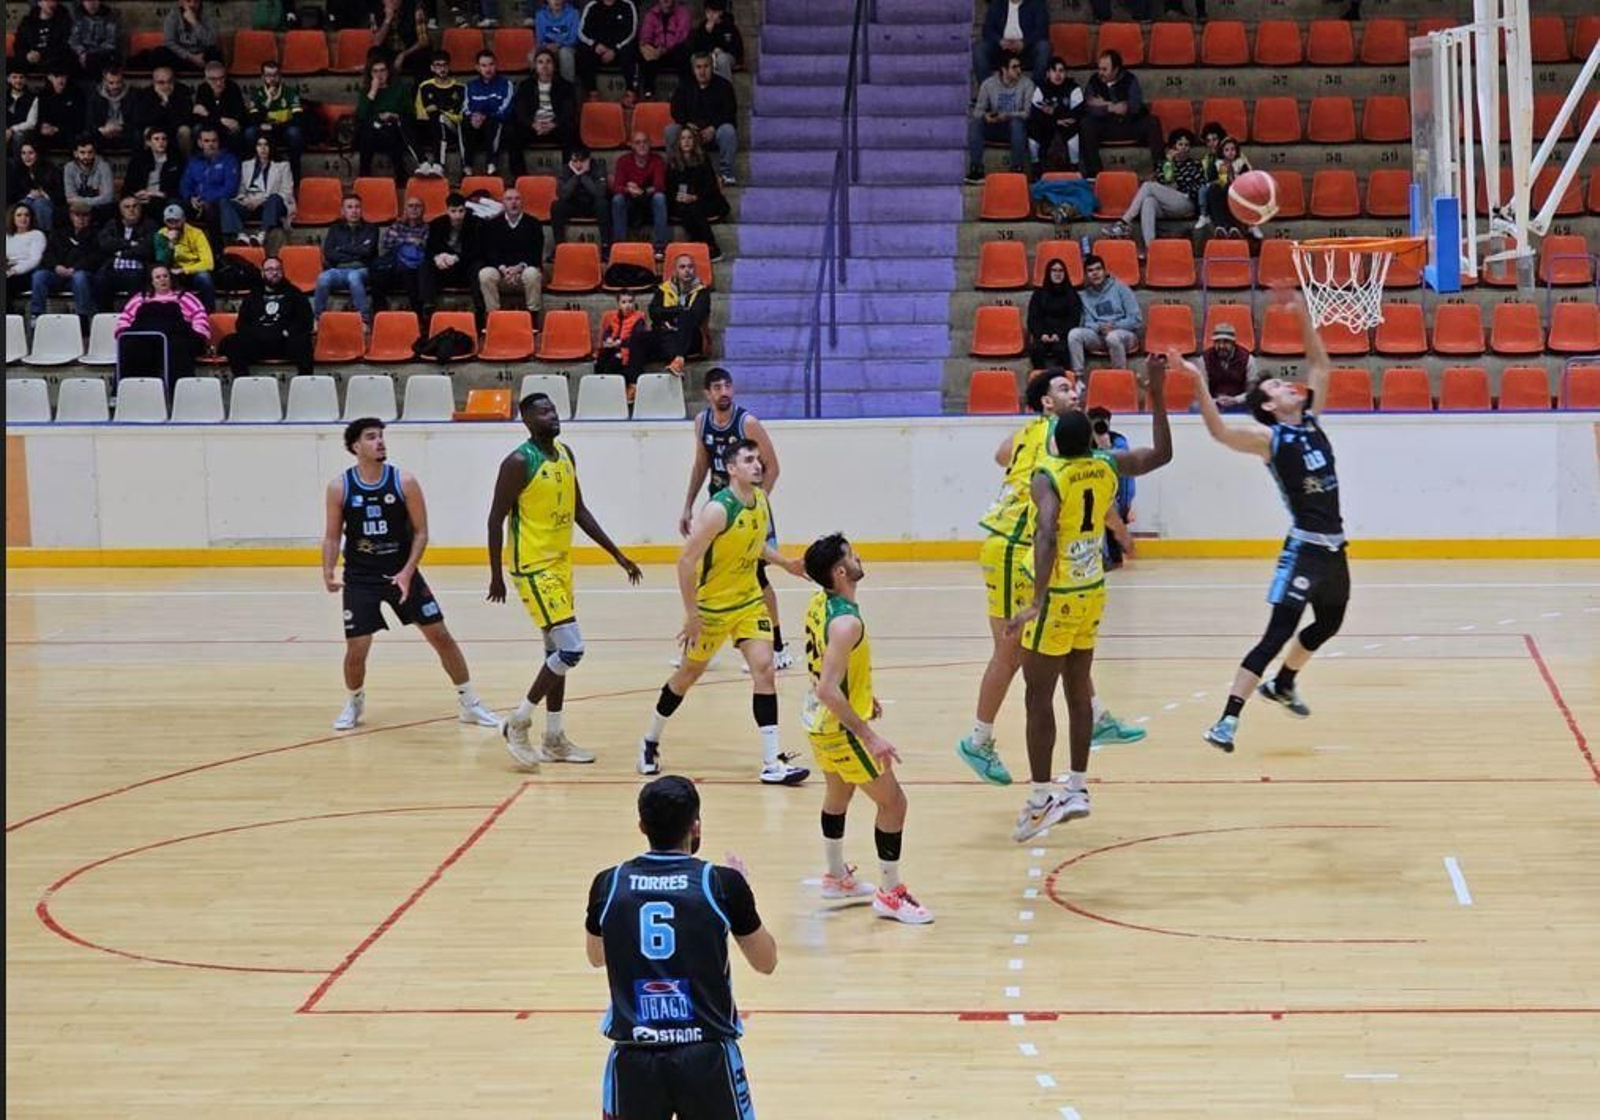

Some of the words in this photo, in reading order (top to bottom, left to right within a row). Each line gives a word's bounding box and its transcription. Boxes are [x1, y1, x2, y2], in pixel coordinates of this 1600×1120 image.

[1080, 488, 1095, 533] 1
[363, 521, 388, 535] ULB
[629, 875, 689, 890] TORRES
[640, 901, 675, 960] 6
